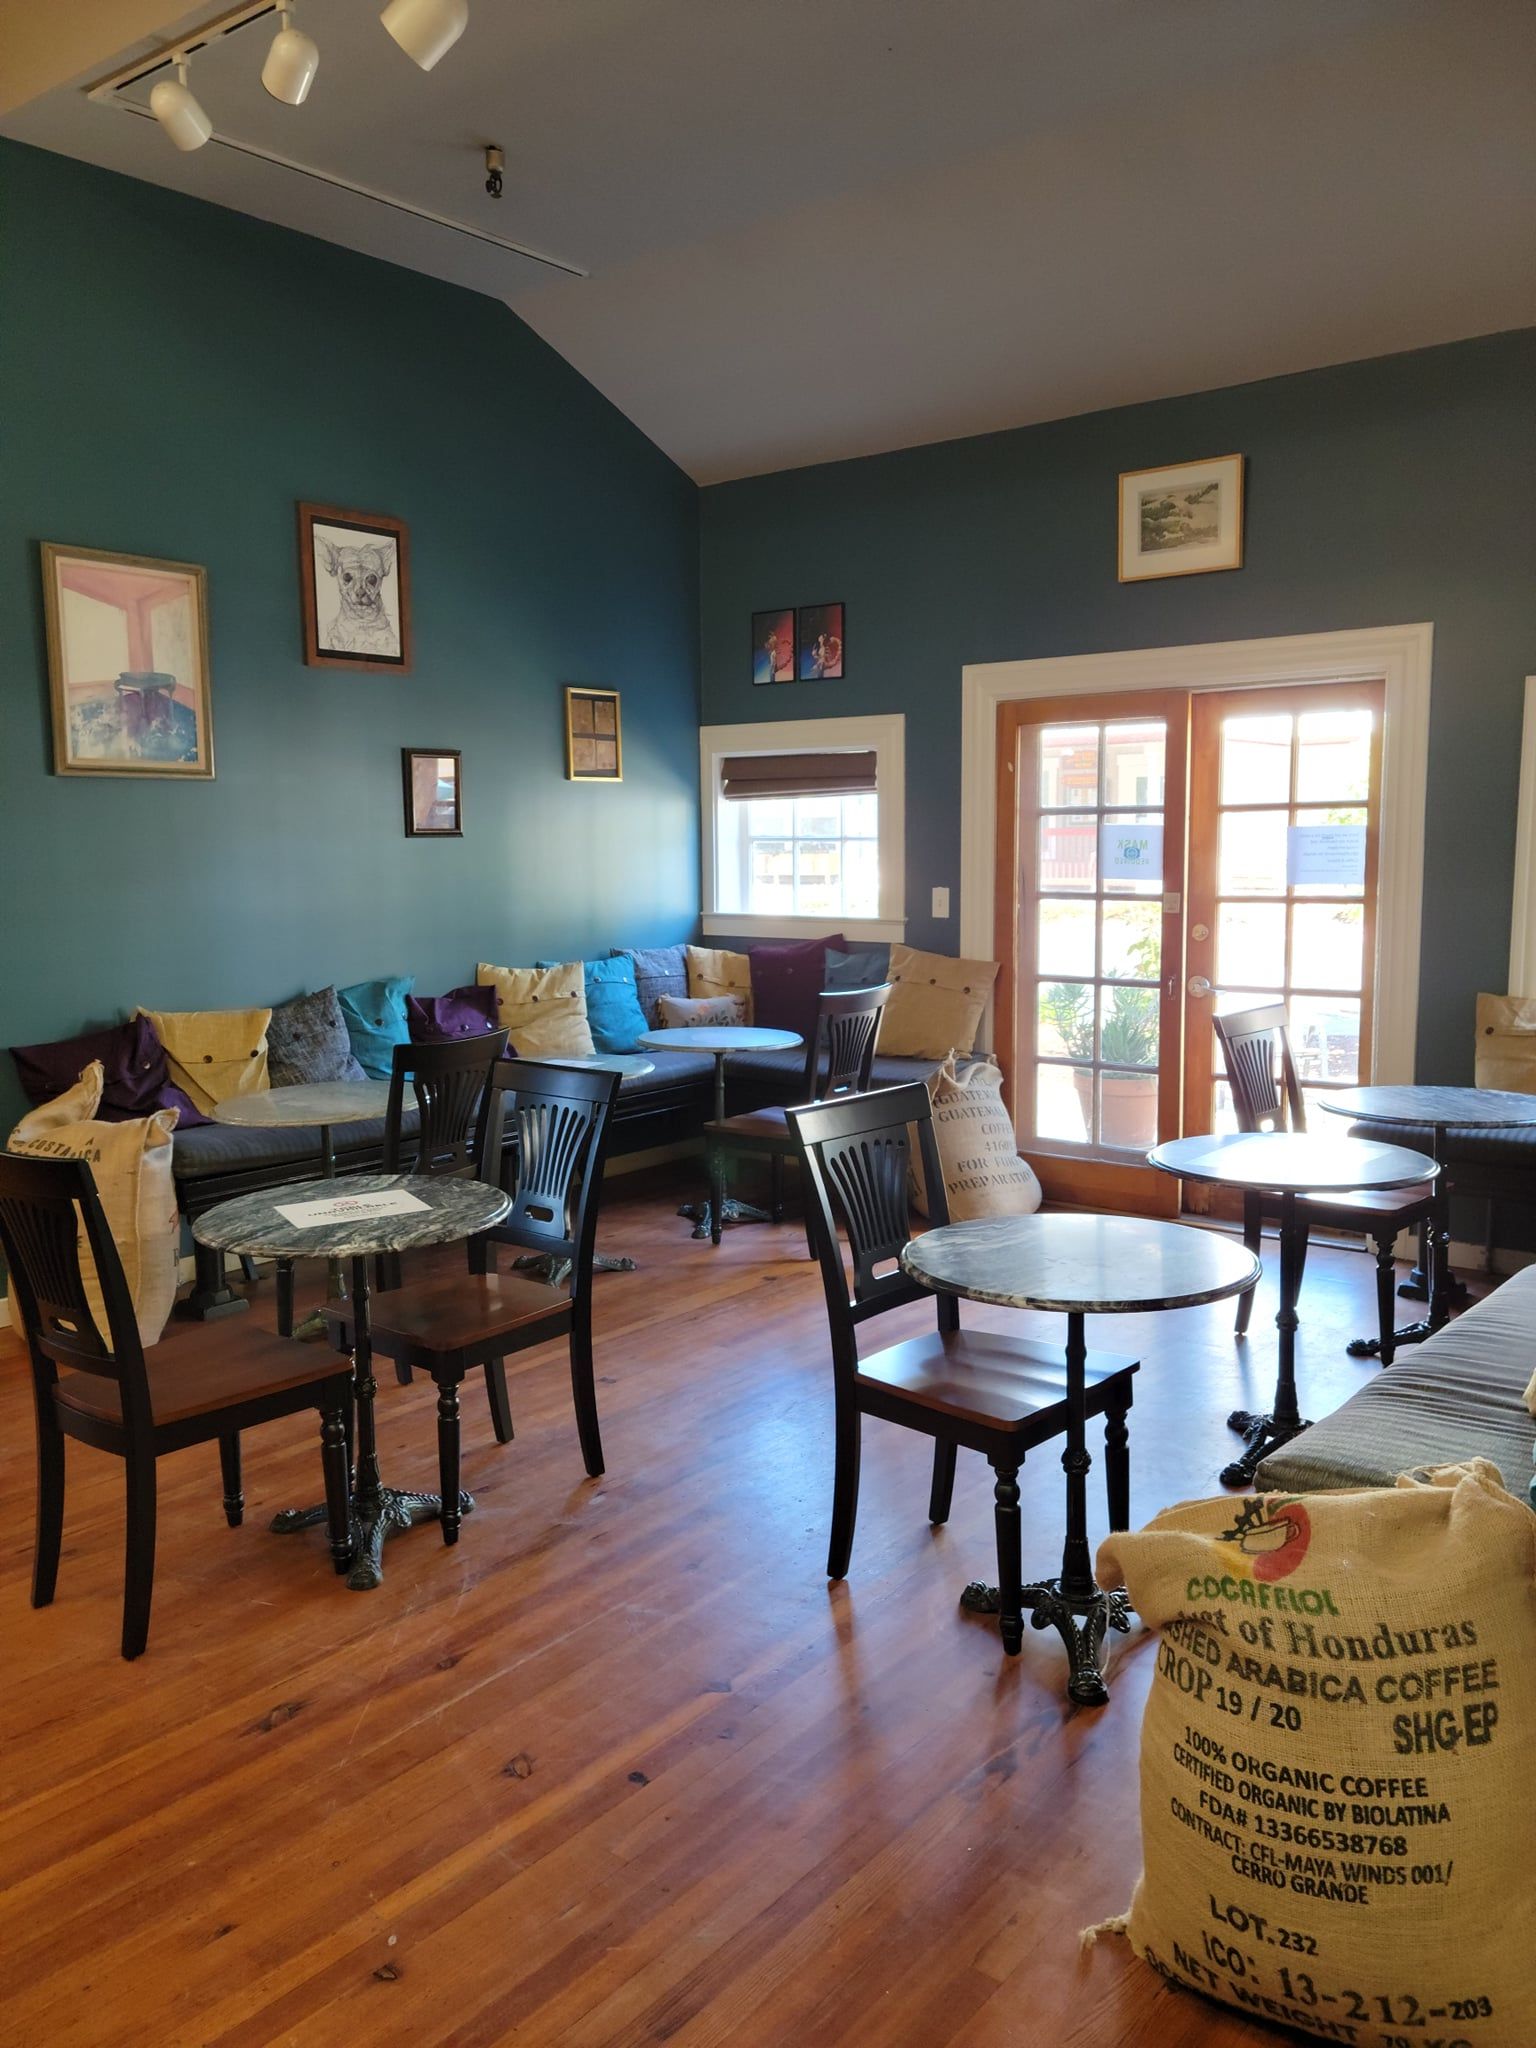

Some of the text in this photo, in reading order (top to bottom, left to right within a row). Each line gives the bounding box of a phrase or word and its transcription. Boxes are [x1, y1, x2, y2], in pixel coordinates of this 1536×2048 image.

[28, 1139, 72, 1156] COSTA
[957, 1158, 988, 1172] FOR
[1239, 1616, 1275, 1651] of
[1282, 1618, 1478, 1662] Honduras
[1157, 1638, 1212, 1701] CROP
[1225, 1650, 1368, 1704] ARABICA
[1374, 1657, 1499, 1703] COFFEE
[1173, 1742, 1451, 1827] CERTIFIED ORGANIC BY BIOLATINA
[1185, 1725, 1429, 1799] 100% ORGANIC COFFEE
[1171, 1797, 1246, 1856] CONTRACT:
[1250, 1842, 1337, 1881] CFL-MAYA
[1340, 1860, 1407, 1886] WINDS
[1200, 1790, 1408, 1857] FDA# 13366538768
[1231, 1854, 1369, 1905] CERRO GRANDE
[1202, 1930, 1260, 1985] ICO:
[1173, 1940, 1220, 1990] NET
[1228, 1981, 1359, 2042] WEIGHT
